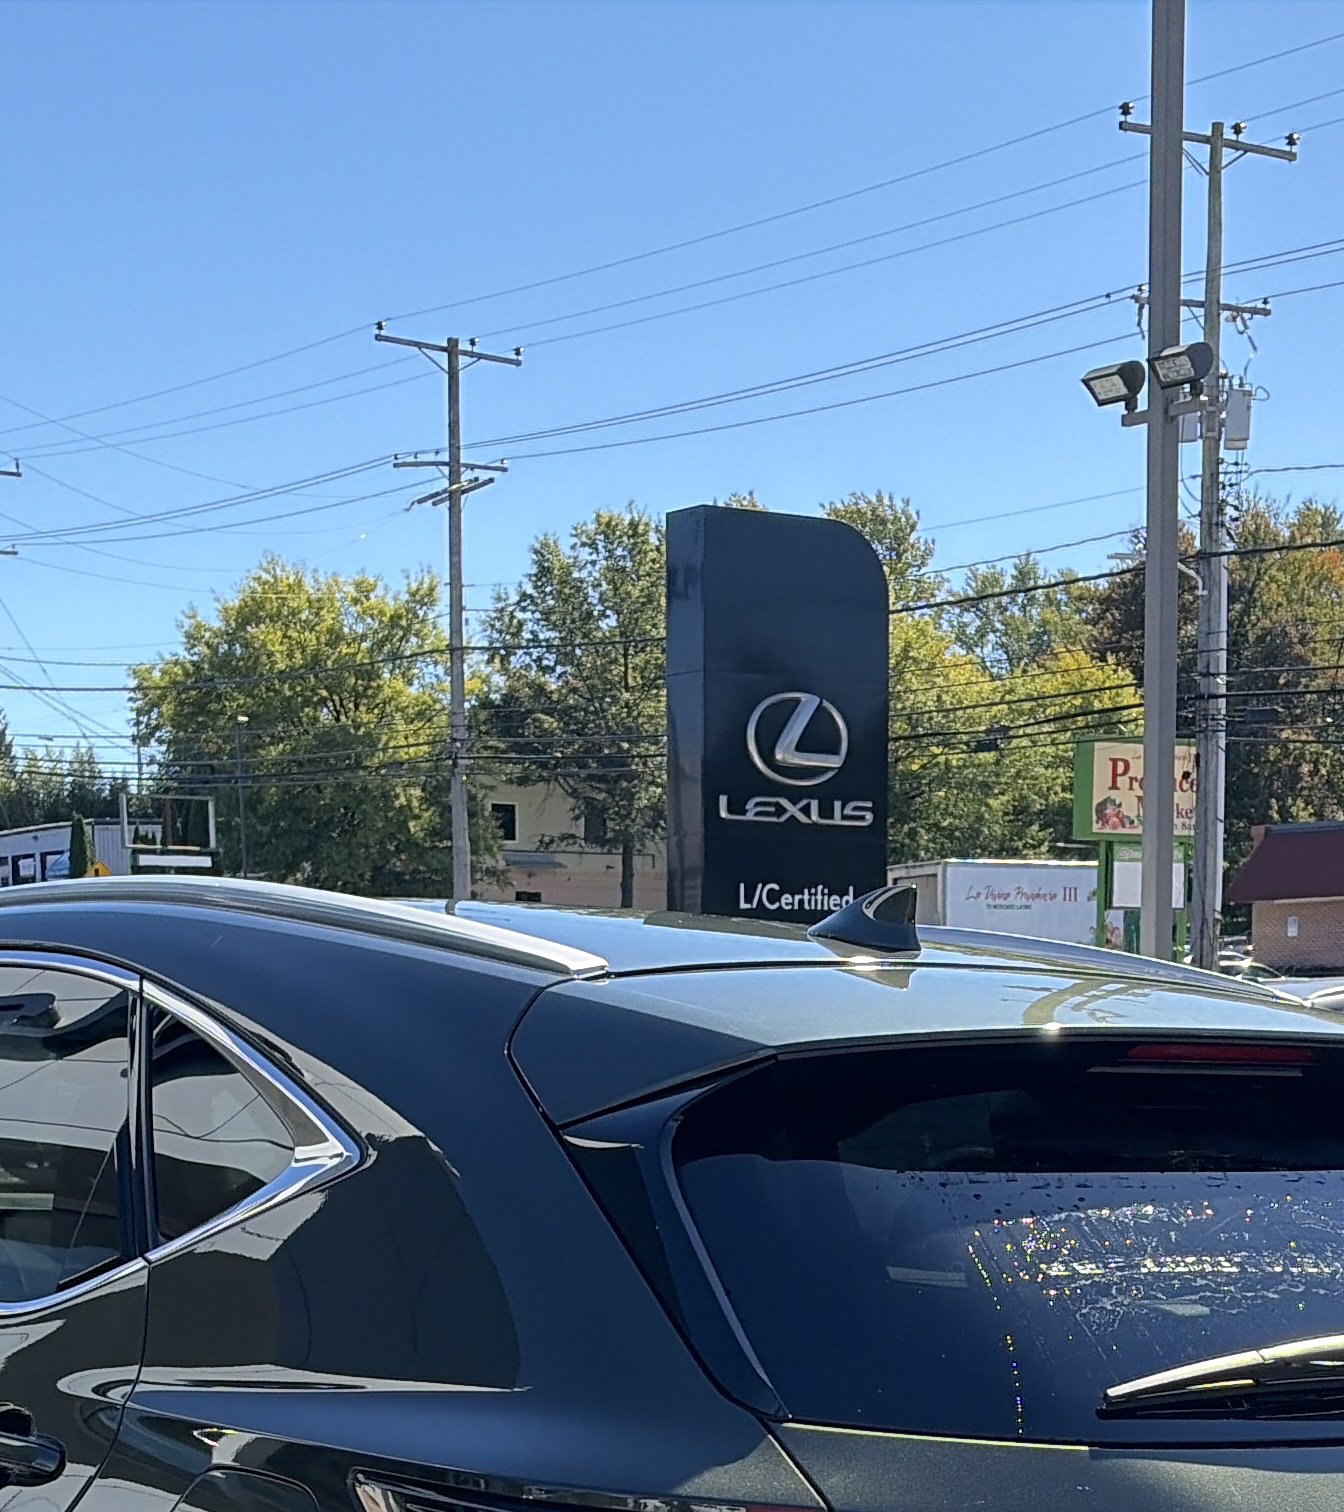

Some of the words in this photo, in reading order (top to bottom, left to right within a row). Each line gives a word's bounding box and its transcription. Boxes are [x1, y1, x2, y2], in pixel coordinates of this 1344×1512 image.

[1109, 757, 1200, 793] Prce
[718, 794, 874, 827] LEXUS
[739, 882, 855, 911] L/Certified
[1062, 886, 1078, 902] III
